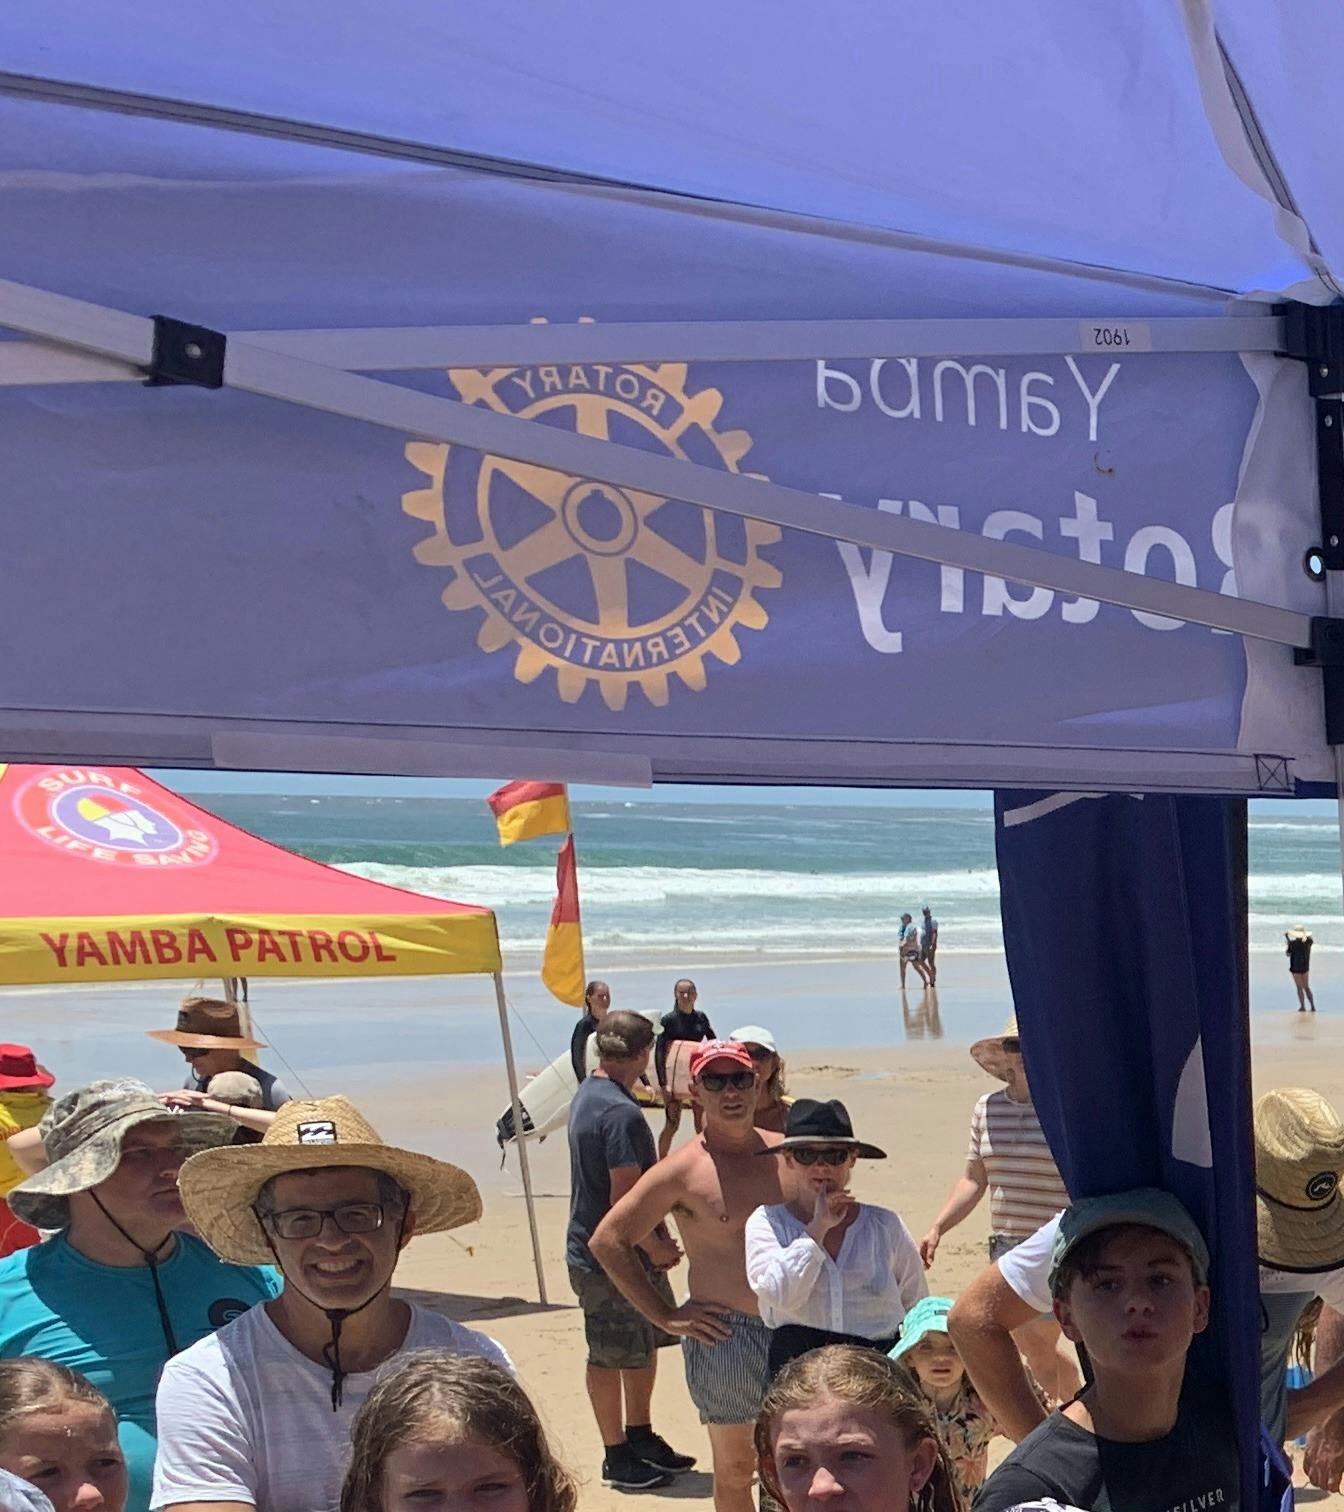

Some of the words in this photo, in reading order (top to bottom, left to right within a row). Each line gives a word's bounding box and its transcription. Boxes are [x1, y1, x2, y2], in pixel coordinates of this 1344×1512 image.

[1093, 328, 1131, 346] 1902
[37, 770, 142, 796] SURF
[36, 825, 119, 863] LIFE
[132, 827, 211, 867] SAVING
[38, 927, 219, 969] YAMBA
[224, 928, 397, 963] PATROL
